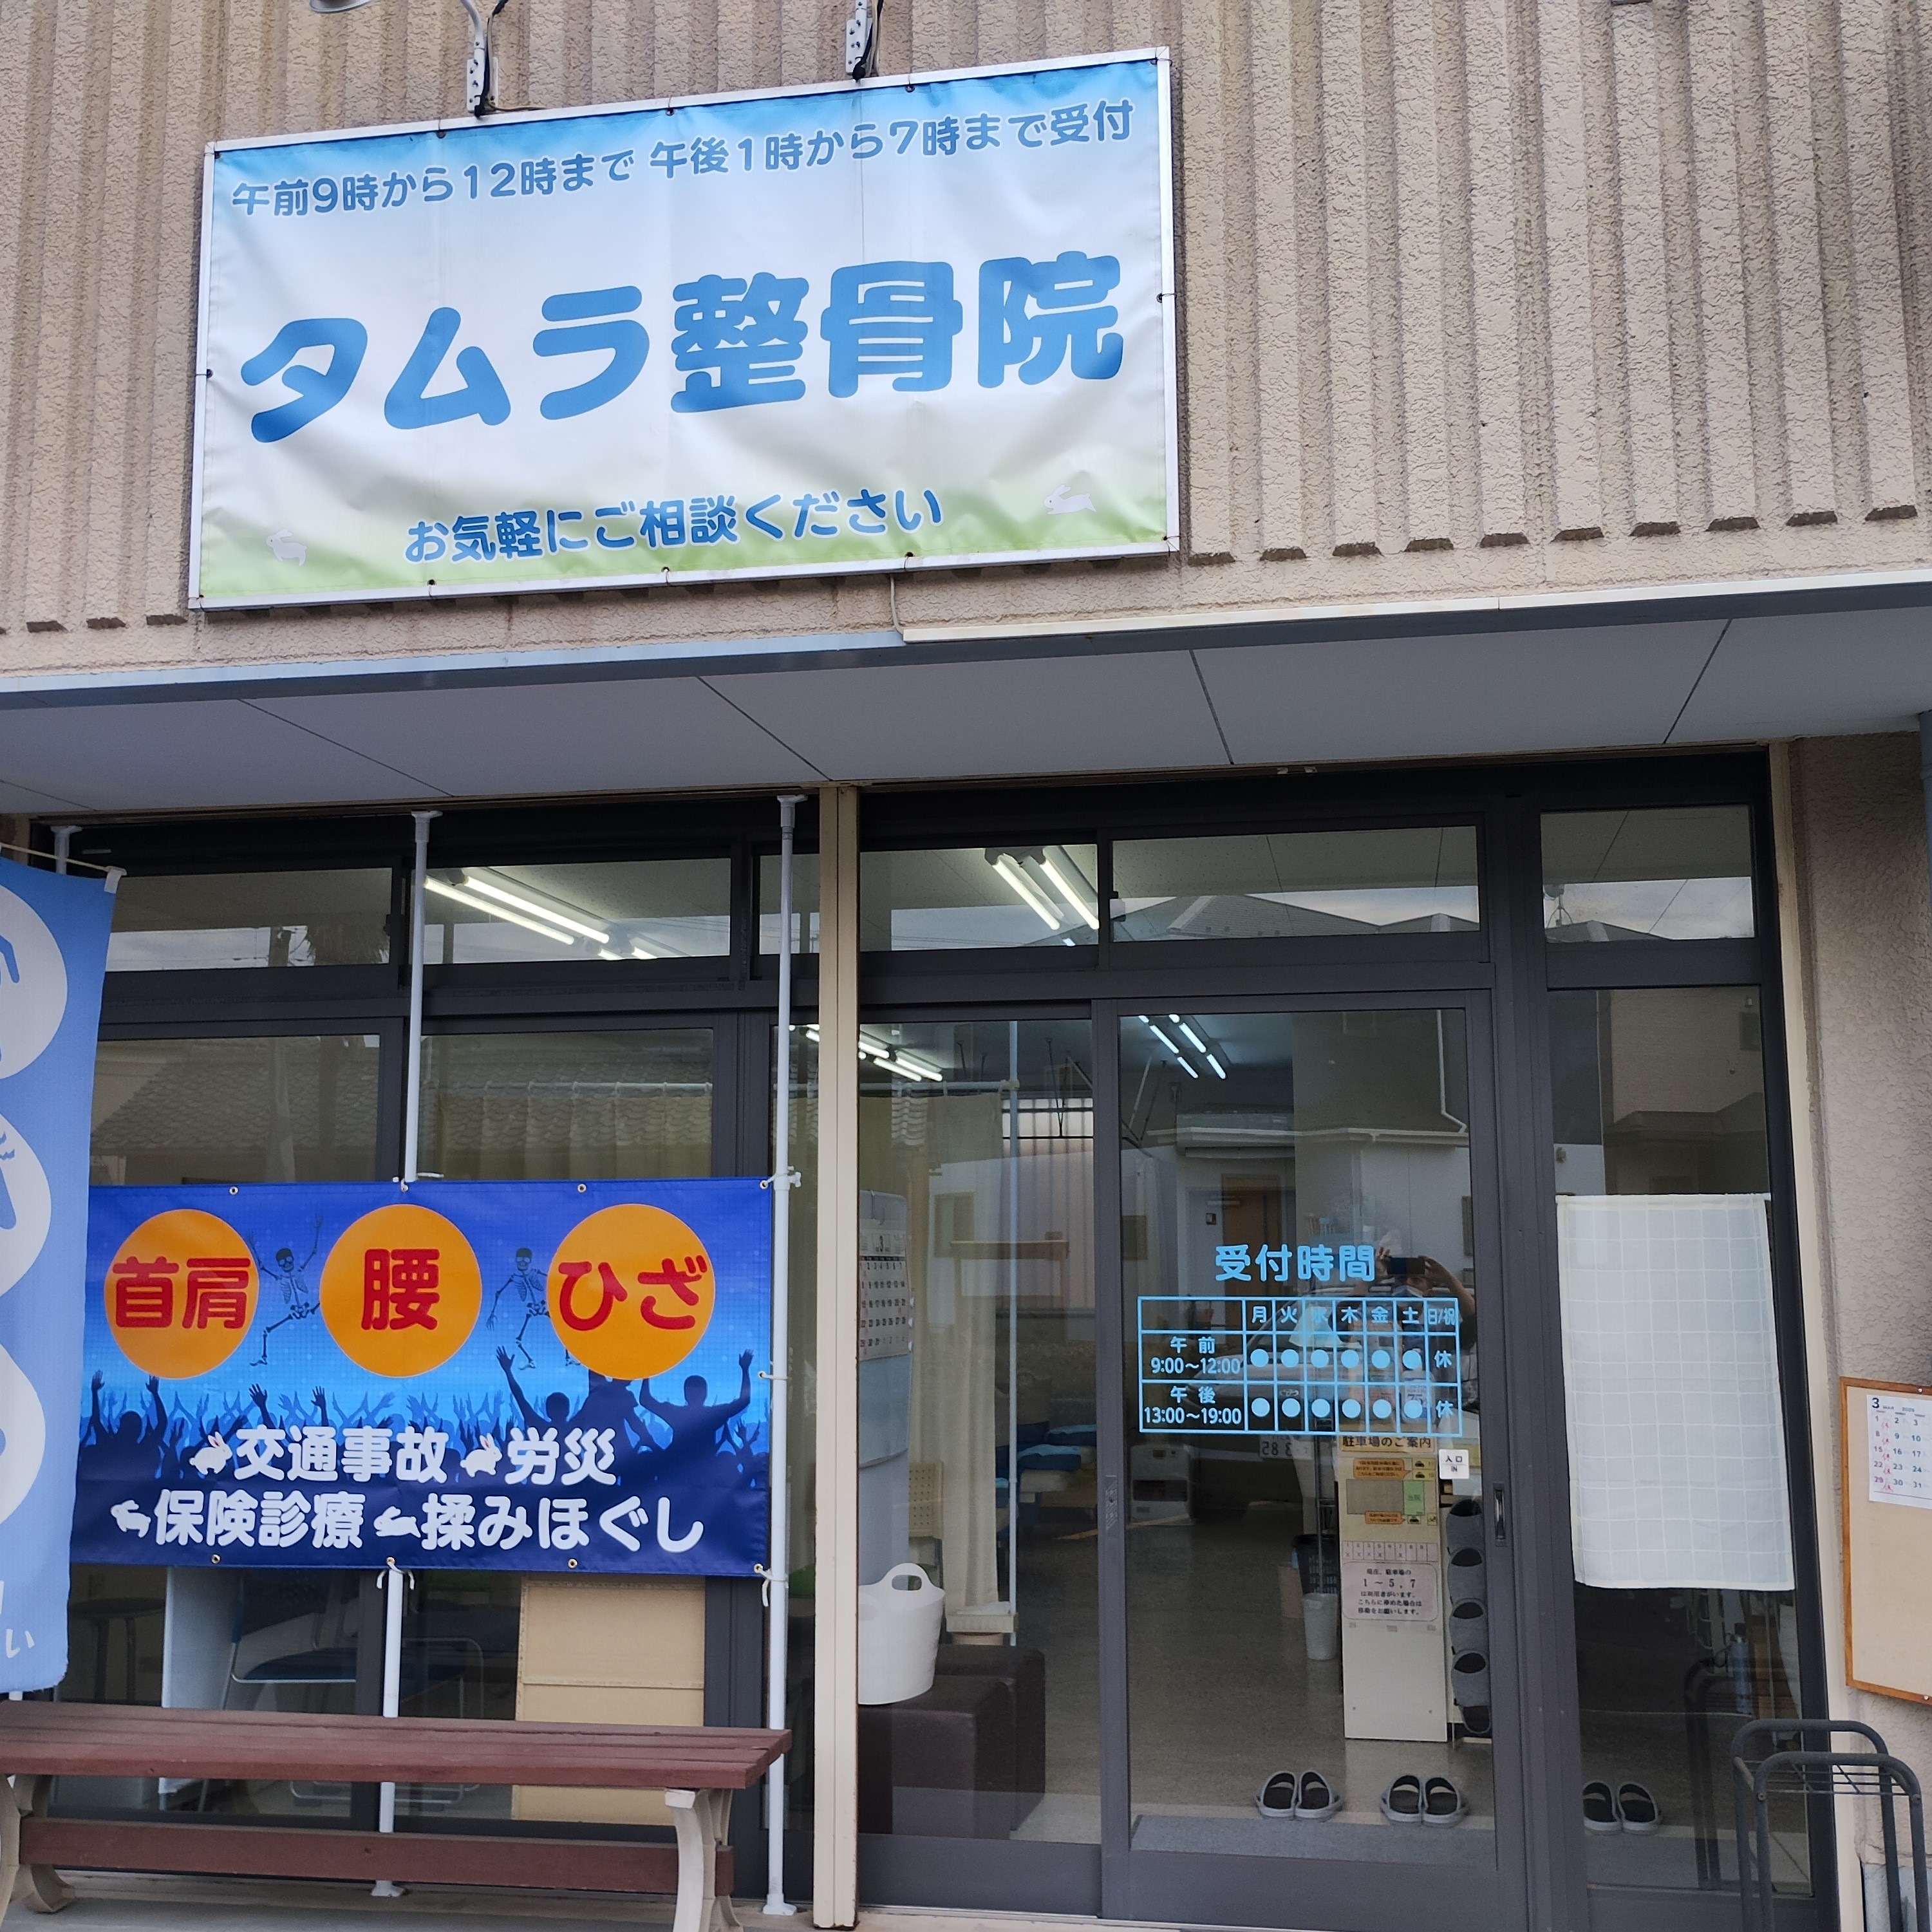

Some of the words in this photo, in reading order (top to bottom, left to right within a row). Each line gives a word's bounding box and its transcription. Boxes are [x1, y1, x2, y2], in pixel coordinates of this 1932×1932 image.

[232, 149, 633, 216] 午前9時から12時まで
[650, 100, 1134, 178] 午後1時から7時まで受付
[241, 250, 1123, 443] タムラ整骨院
[405, 489, 943, 563] お気軽にご相談ください
[361, 1248, 440, 1331] 腰
[1215, 1244, 1375, 1282] 受付時間
[113, 1256, 251, 1329] 首肩
[558, 1255, 708, 1331] ひざ
[1251, 1306, 1266, 1324] 月
[1280, 1307, 1297, 1324] 火
[1341, 1306, 1359, 1324] 木
[1371, 1306, 1389, 1324] 金
[1402, 1307, 1420, 1324] 土
[1170, 1336, 1215, 1355] 午前
[1434, 1350, 1452, 1368] 休
[1170, 1385, 1216, 1404] 午後
[1436, 1400, 1454, 1418] 休
[1871, 1398, 1880, 1409] 3
[234, 1425, 449, 1484] 交通事故
[505, 1427, 616, 1485] 労災
[1342, 1436, 1431, 1448] 駐車場のご案内
[1445, 1455, 1463, 1463] 入口
[154, 1489, 366, 1549] 保険診療
[422, 1492, 704, 1553] 揉みほぐし
